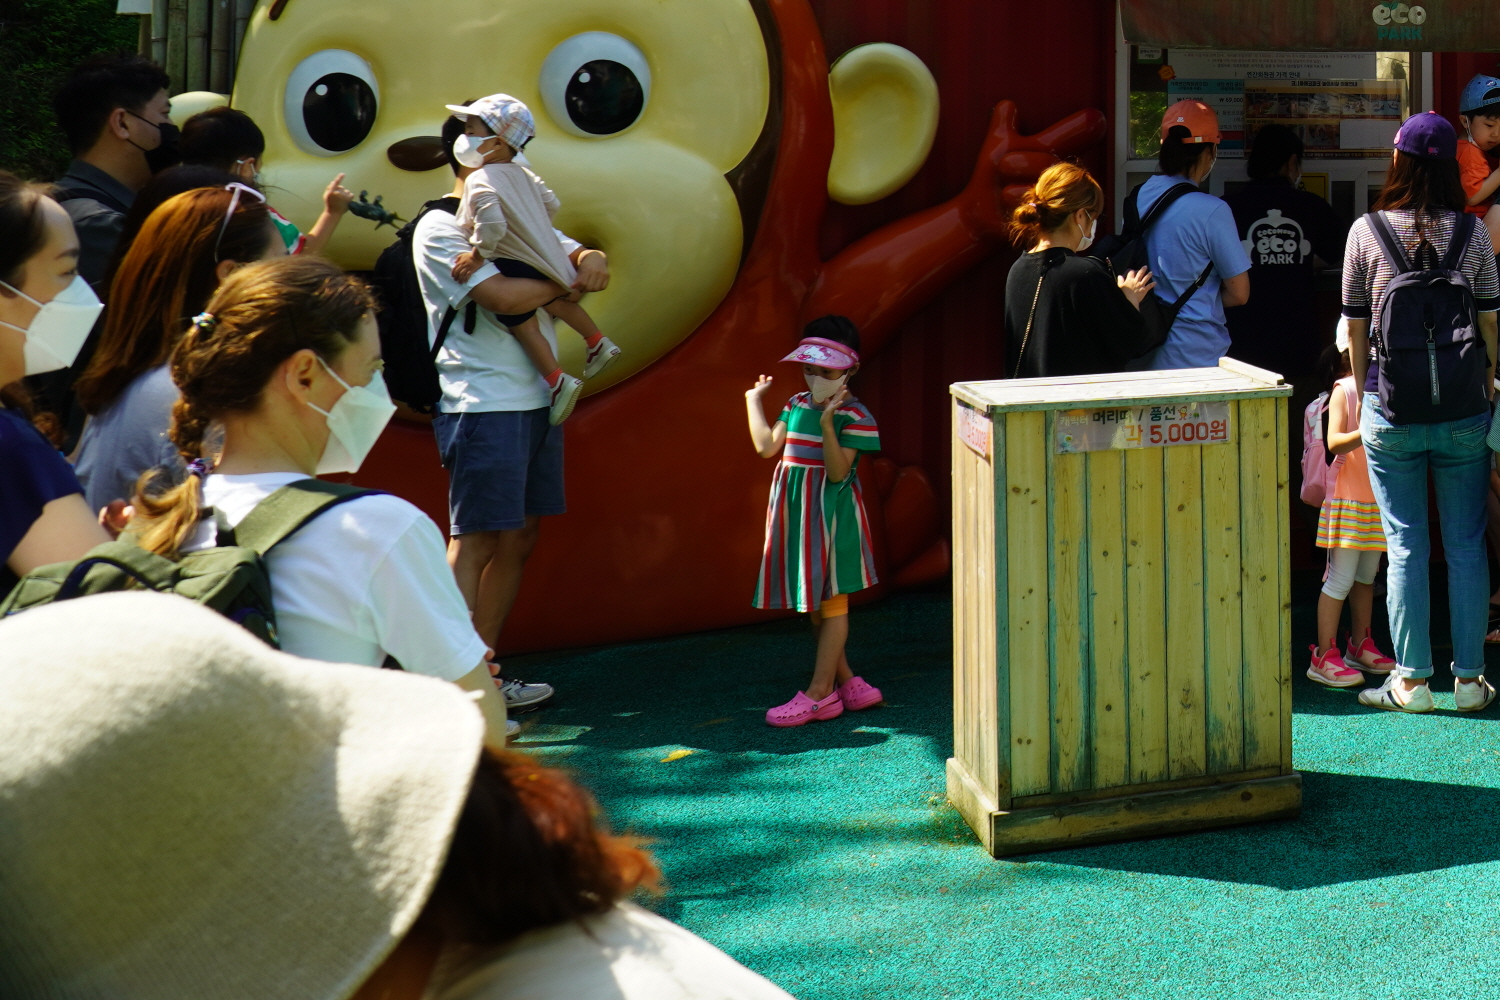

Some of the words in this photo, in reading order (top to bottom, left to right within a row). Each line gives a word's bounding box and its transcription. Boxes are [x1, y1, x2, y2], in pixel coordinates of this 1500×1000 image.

[1372, 2, 1427, 26] eco
[1377, 26, 1424, 41] PARK
[1257, 235, 1297, 254] eco
[1260, 254, 1294, 264] PARK
[1060, 415, 1089, 427] 캐릭터
[1150, 406, 1176, 422] 풍선
[1124, 423, 1144, 446] 각
[1150, 419, 1227, 444] 5,000원
